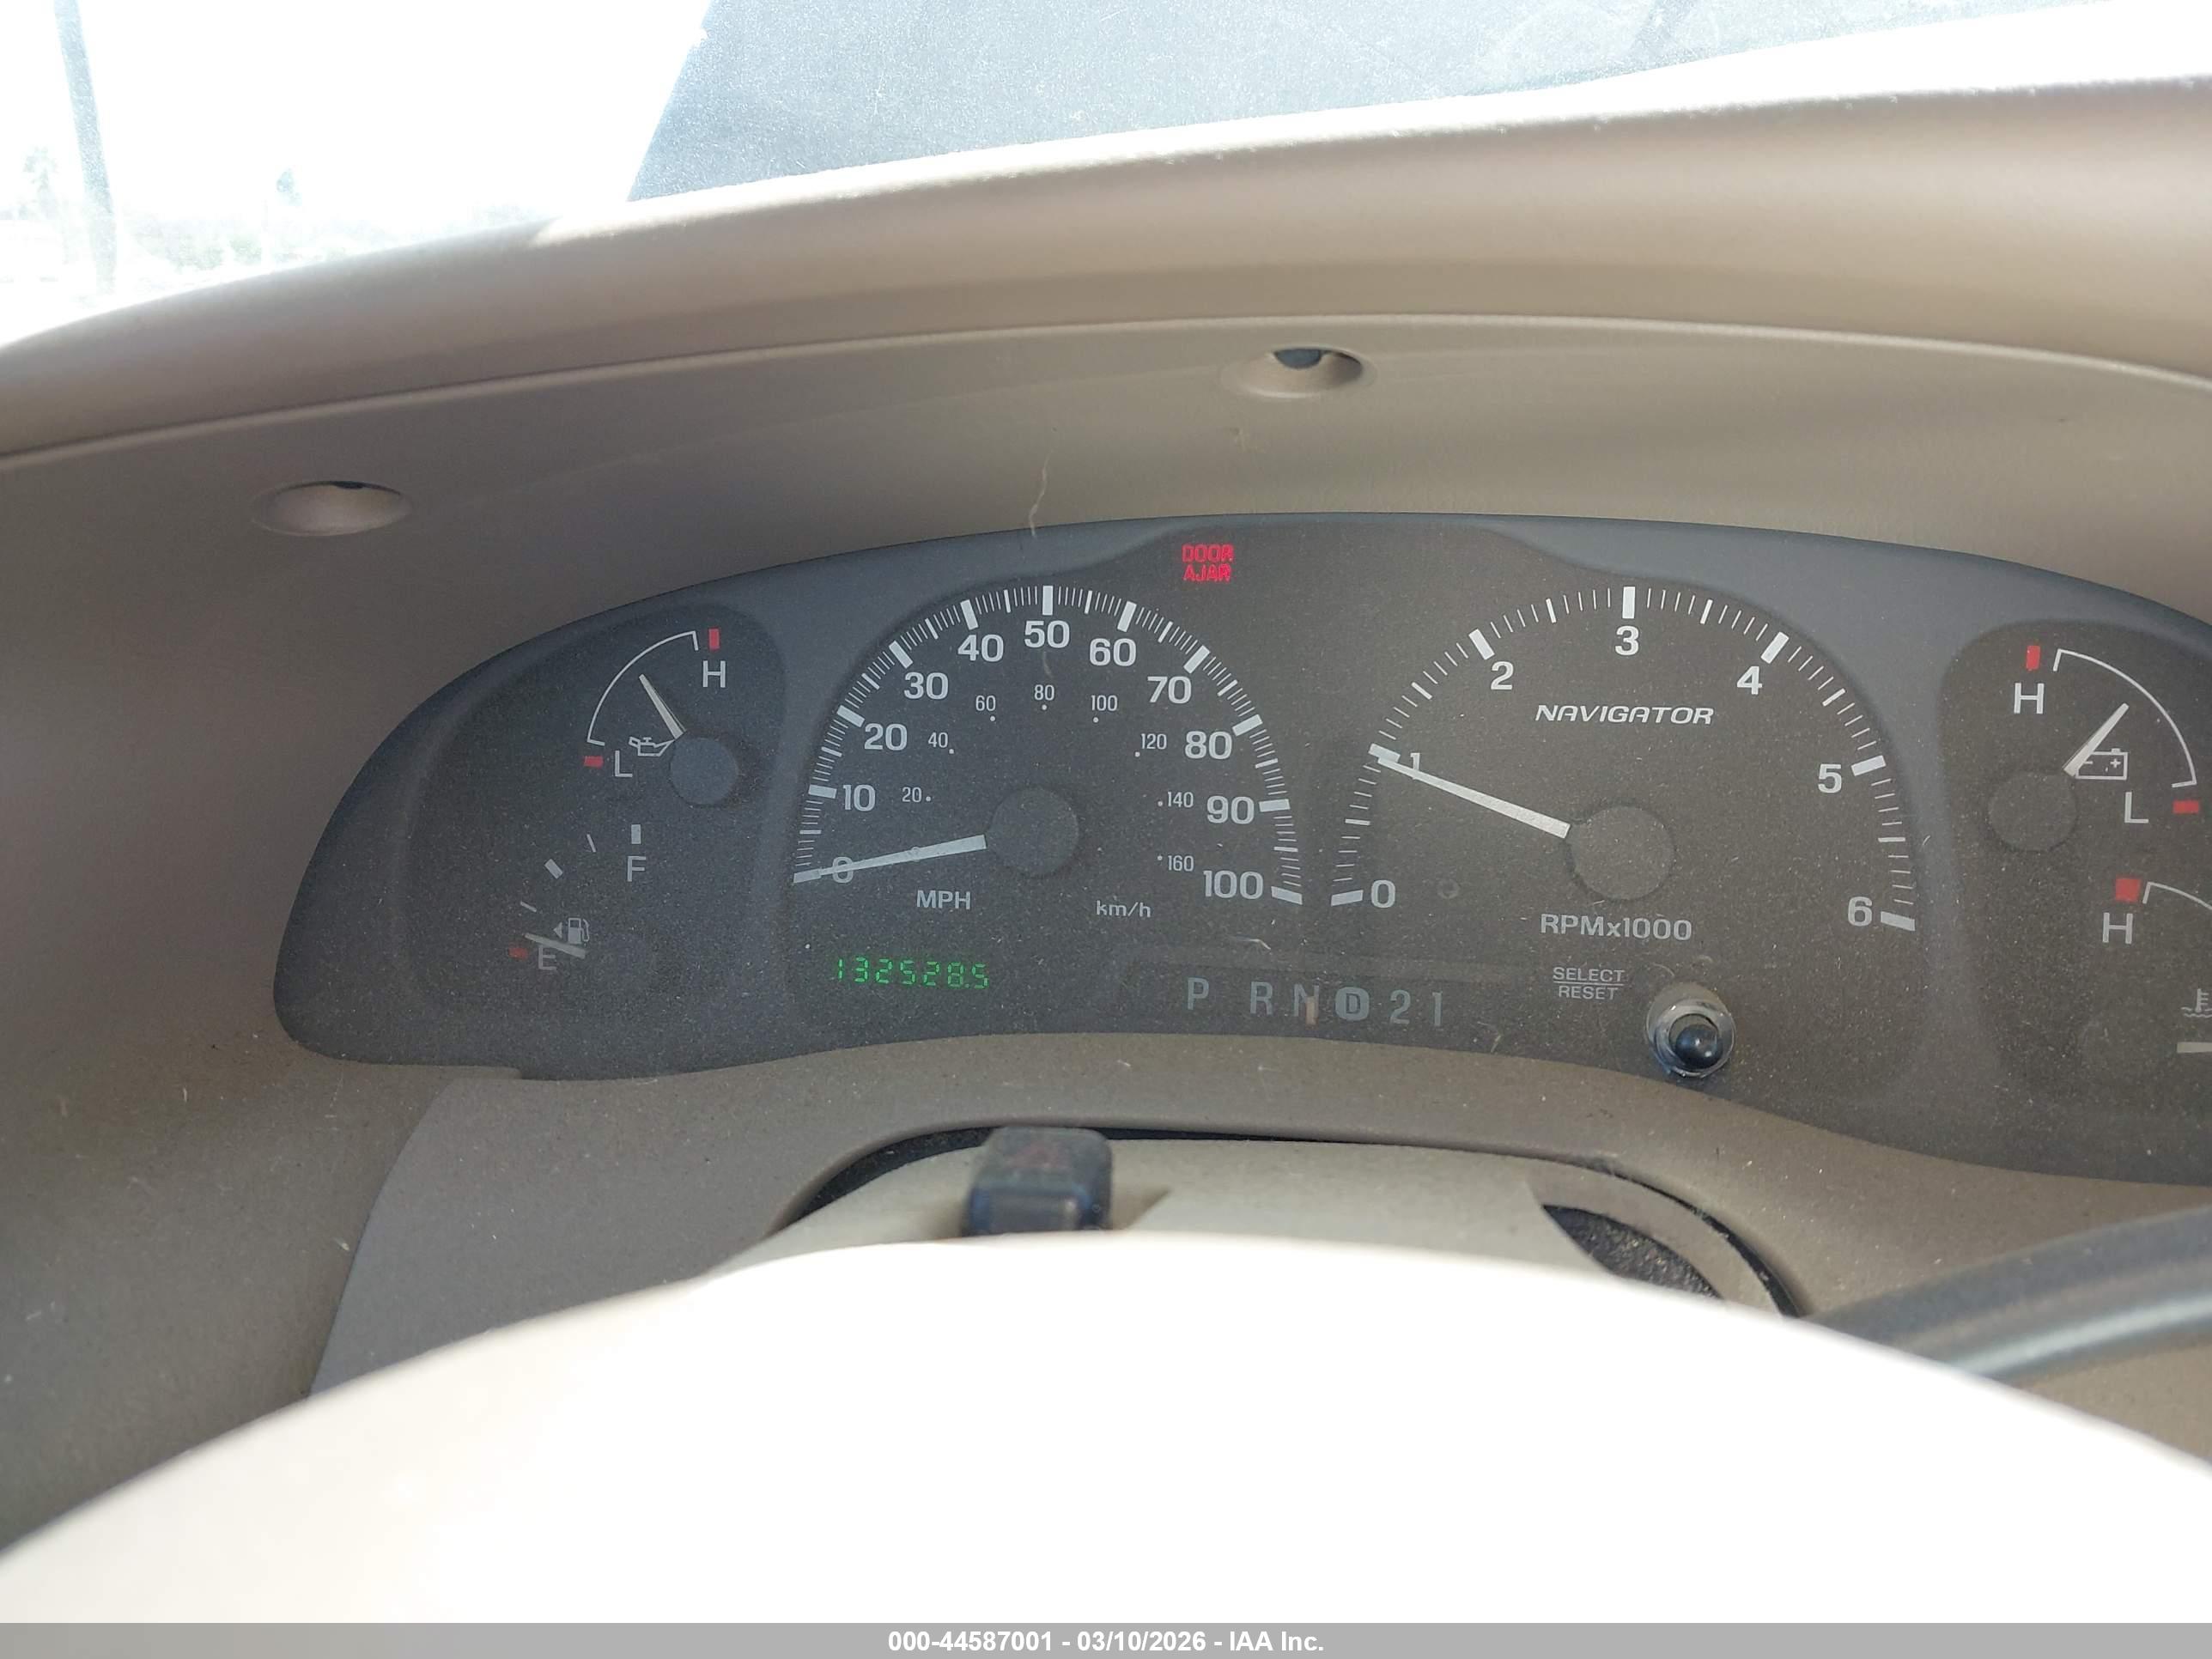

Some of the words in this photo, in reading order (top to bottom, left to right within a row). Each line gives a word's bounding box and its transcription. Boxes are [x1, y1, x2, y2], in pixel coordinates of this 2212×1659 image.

[1182, 544, 1234, 562] DOOR
[1183, 563, 1231, 582] AJAR
[1025, 621, 1069, 647] 50
[1616, 626, 1638, 655] 3
[958, 635, 1003, 661] 40
[1090, 638, 1136, 665] 60
[703, 661, 726, 688] H
[904, 672, 948, 699] 30
[1491, 661, 1513, 690] 2
[1737, 666, 1762, 695] 4
[1035, 685, 1054, 700] 80
[1148, 677, 1191, 703] 70
[2014, 683, 2044, 714] H
[976, 696, 995, 711] 60
[1092, 696, 1117, 711] 100
[1536, 705, 1713, 724] NAVIGATOR
[865, 724, 907, 750] 20
[928, 732, 948, 747] 40
[1142, 733, 1166, 749] 120
[1185, 731, 1231, 759] 80
[615, 750, 633, 777] L
[1819, 764, 1842, 793] 5
[843, 785, 875, 811] 10
[902, 787, 921, 802] 20
[1168, 792, 1194, 807] 140
[2124, 792, 2148, 823] L
[1207, 796, 1254, 823] 90
[628, 856, 647, 882] F
[832, 857, 854, 884] 0
[1169, 855, 1194, 871] 160
[1204, 871, 1263, 899] 100
[1371, 880, 1395, 908] 0
[917, 890, 970, 909] MPH
[1097, 901, 1151, 917] km/h
[1848, 896, 1872, 926] 6
[1541, 914, 1692, 939] RPMx1000
[2103, 913, 2133, 944] H
[538, 944, 557, 970] E
[1553, 967, 1625, 982] SELECT
[1188, 978, 1209, 1009] P
[1250, 981, 1273, 1014] R
[1294, 984, 1319, 1018] N
[1390, 990, 1410, 1024] 2
[1432, 991, 1443, 1026] 1
[1559, 986, 1618, 1000] RESET
